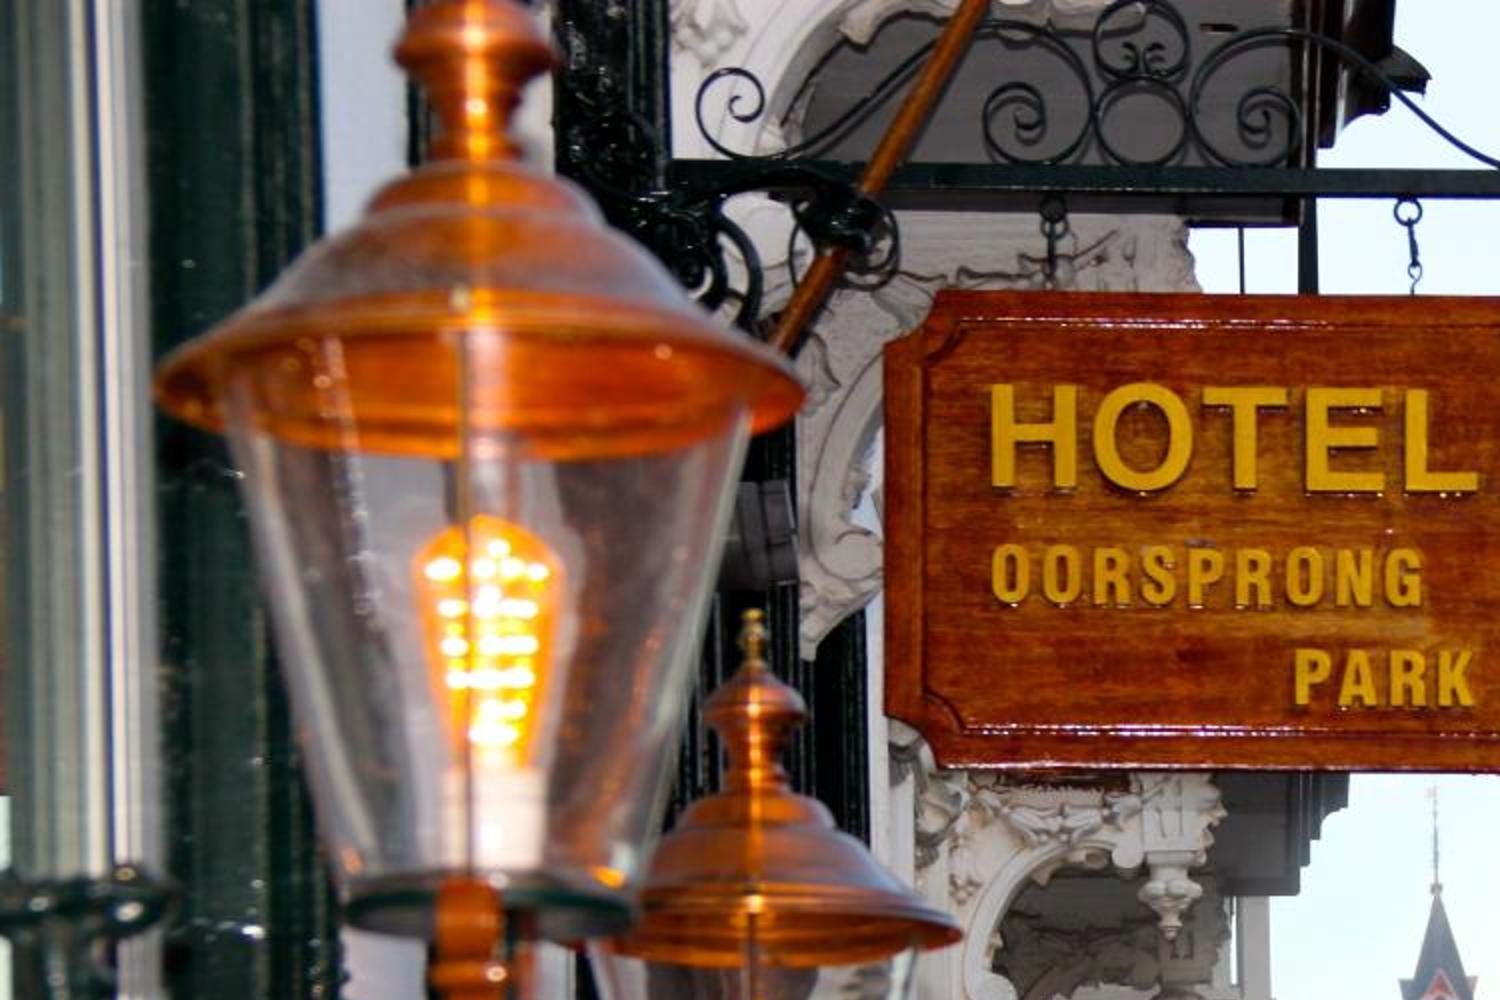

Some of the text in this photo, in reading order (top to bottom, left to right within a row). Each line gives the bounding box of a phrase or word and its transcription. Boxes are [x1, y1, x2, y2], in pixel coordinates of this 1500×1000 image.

[991, 383, 1479, 492] HOTEL
[991, 544, 1423, 607] OORSPRONG
[1294, 648, 1475, 707] PARK
